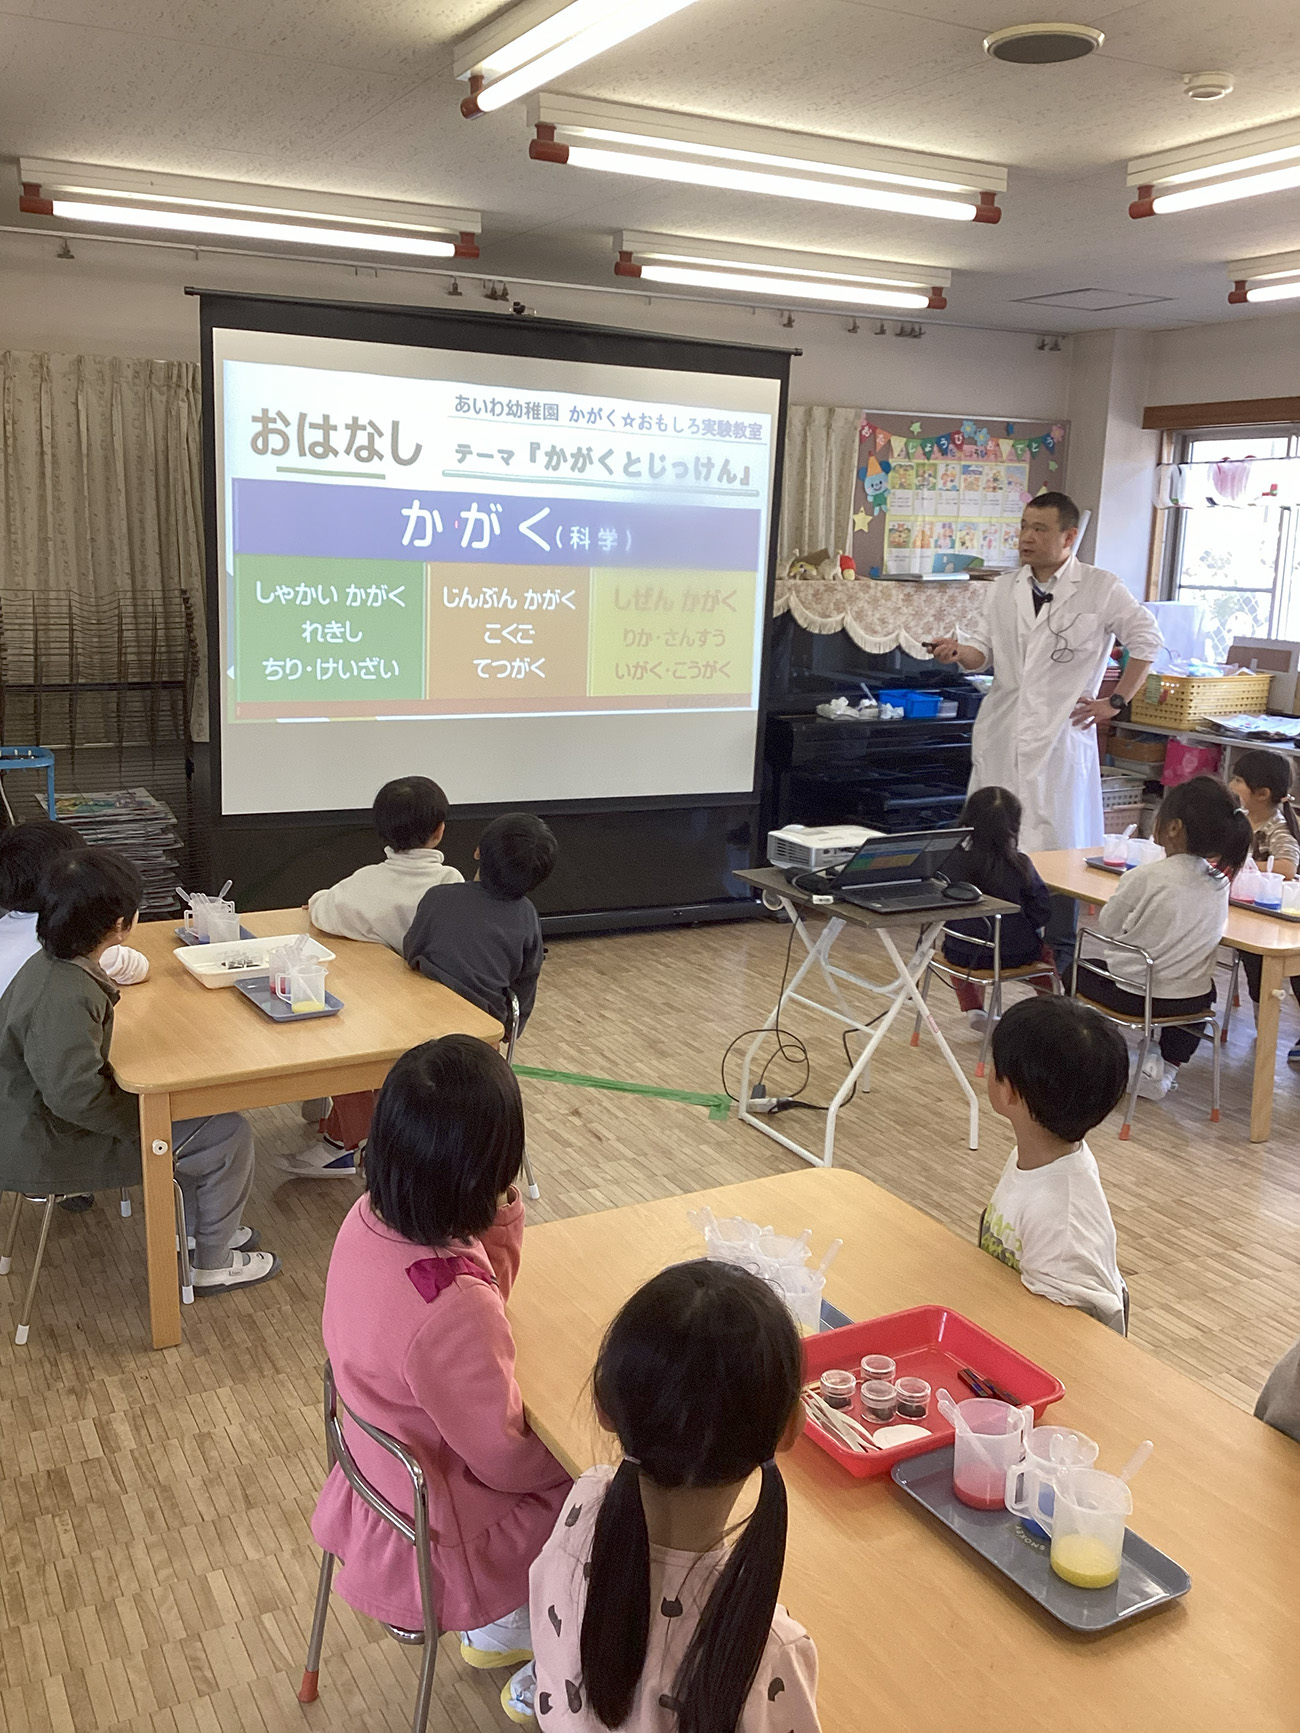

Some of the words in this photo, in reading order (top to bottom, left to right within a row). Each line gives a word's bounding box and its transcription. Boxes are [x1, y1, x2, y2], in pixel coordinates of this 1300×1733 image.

[453, 394, 560, 422] あいわ幼稚園
[568, 404, 764, 441] かがく☆おもしろ実験教室
[250, 407, 423, 467] おはなし
[255, 580, 338, 606] しゃかい
[345, 584, 406, 607] かがく
[442, 585, 518, 609] じんぶん
[523, 587, 576, 610] かがく
[614, 585, 675, 612] しぜん
[681, 587, 738, 613] かがく
[301, 620, 363, 643] れきし
[484, 623, 535, 644] こくご
[262, 657, 400, 681] ちり・けいざい
[473, 657, 546, 679] てつがく
